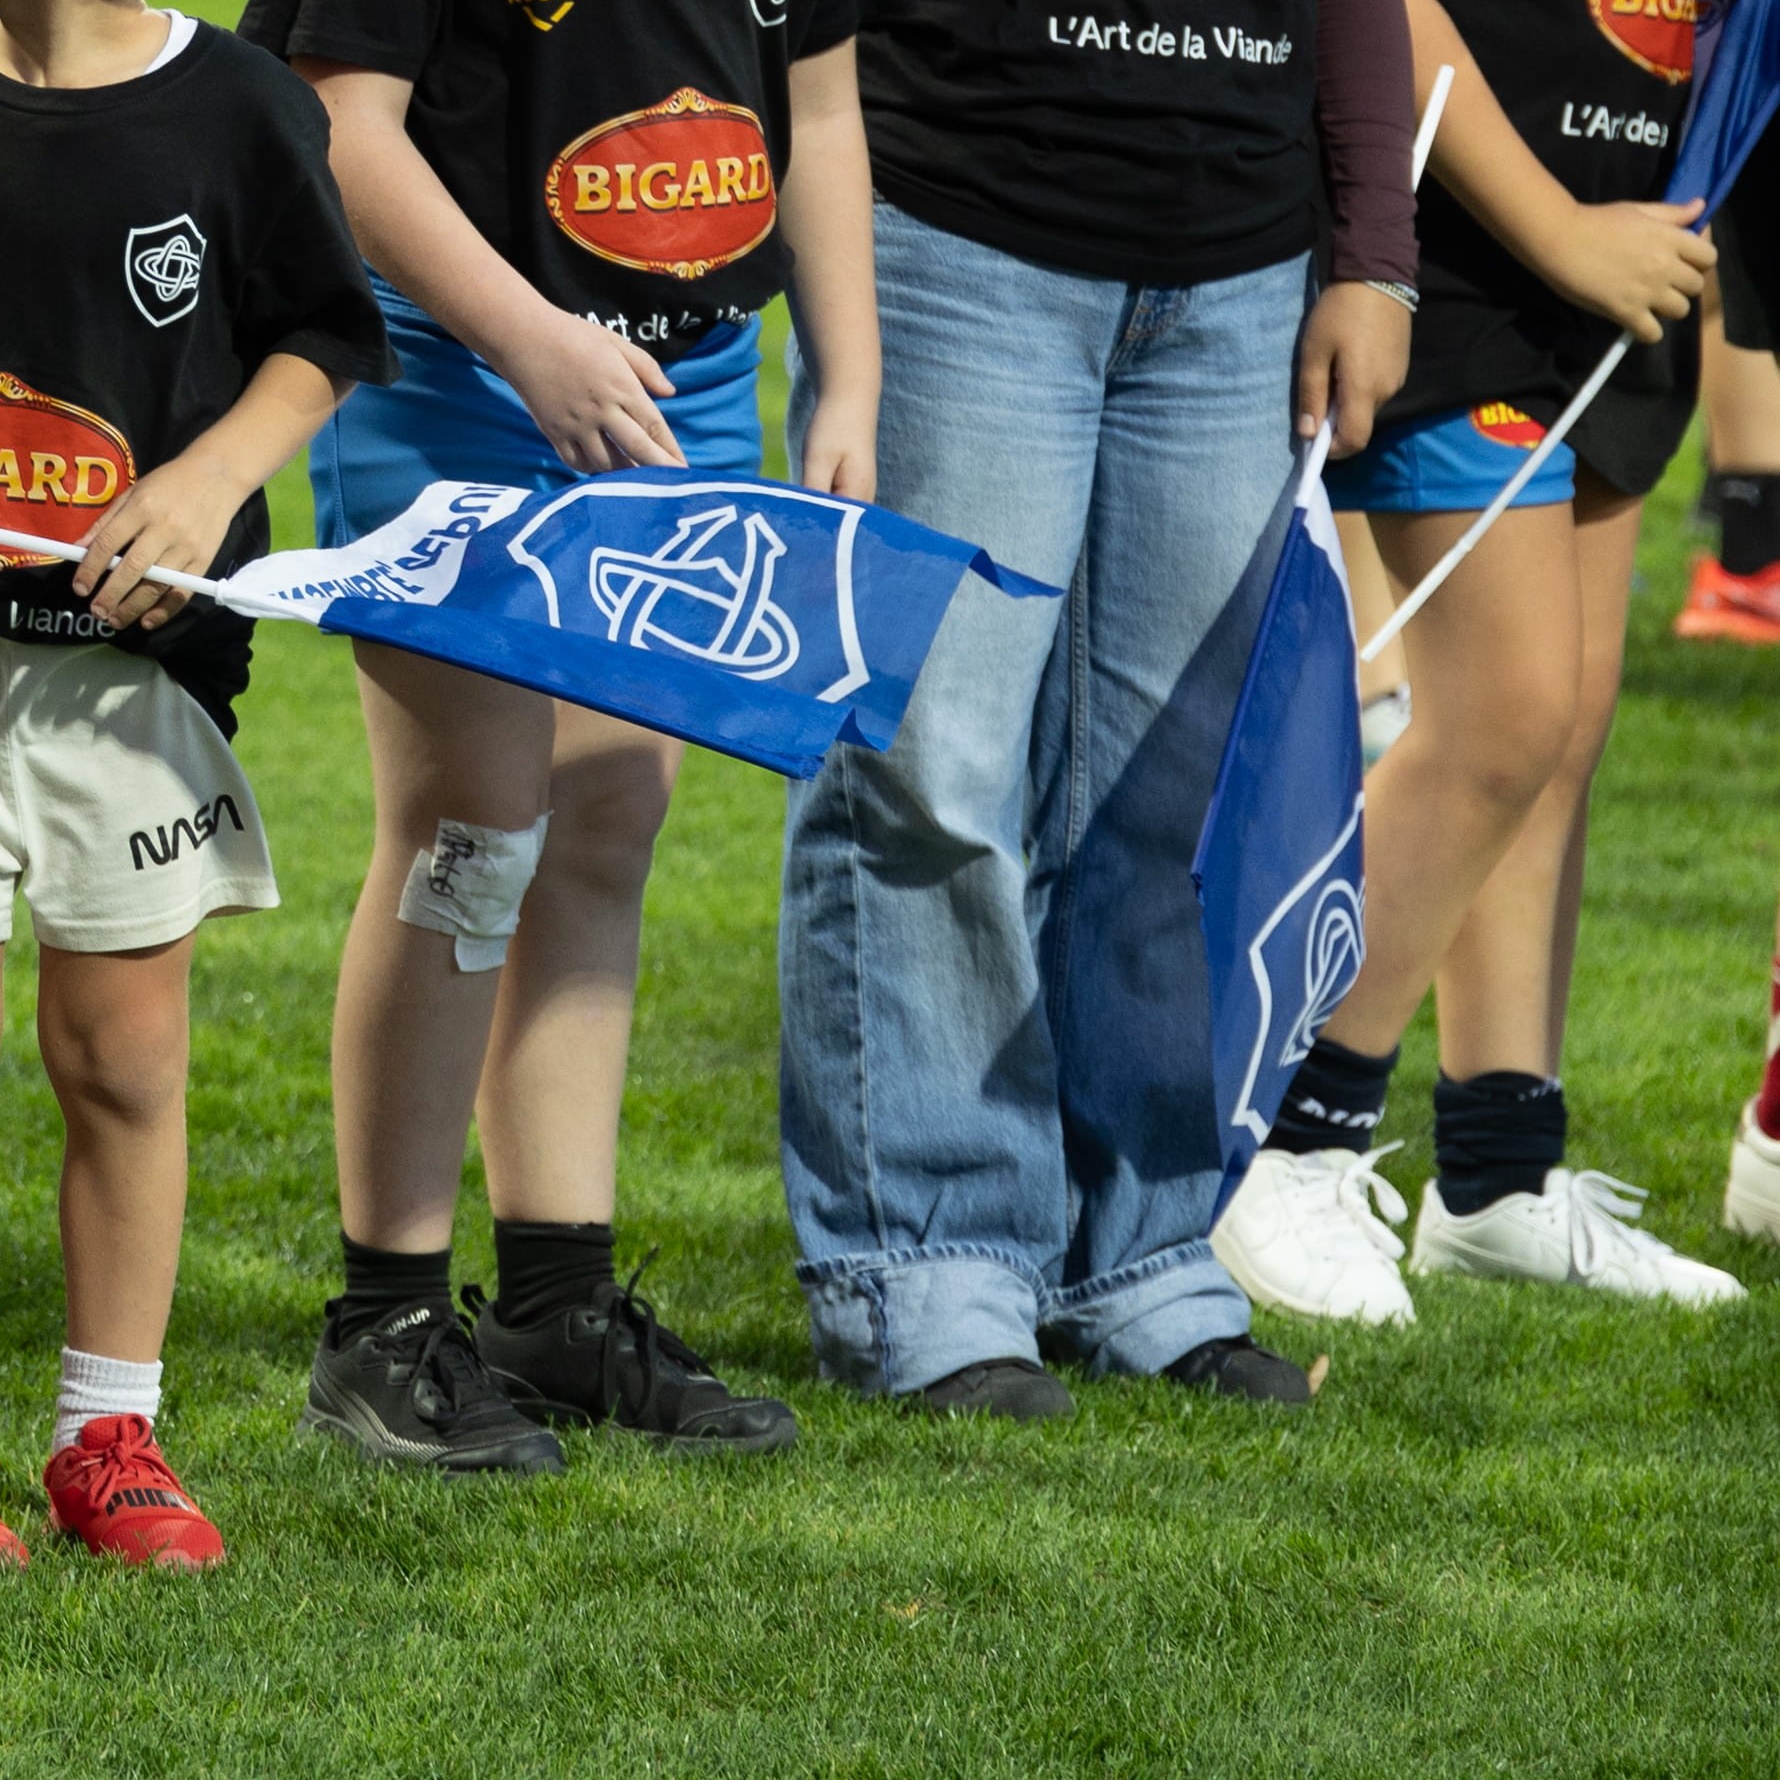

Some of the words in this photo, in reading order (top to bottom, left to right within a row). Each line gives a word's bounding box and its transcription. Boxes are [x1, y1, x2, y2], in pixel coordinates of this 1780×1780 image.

[1048, 16, 1131, 51] L'Art
[1137, 23, 1176, 57] de
[1182, 25, 1207, 59] la
[1213, 26, 1292, 64] Viande
[1625, 110, 1661, 147] de
[573, 152, 771, 217] BIGARD
[637, 313, 670, 342] de
[129, 793, 244, 871] NASA
